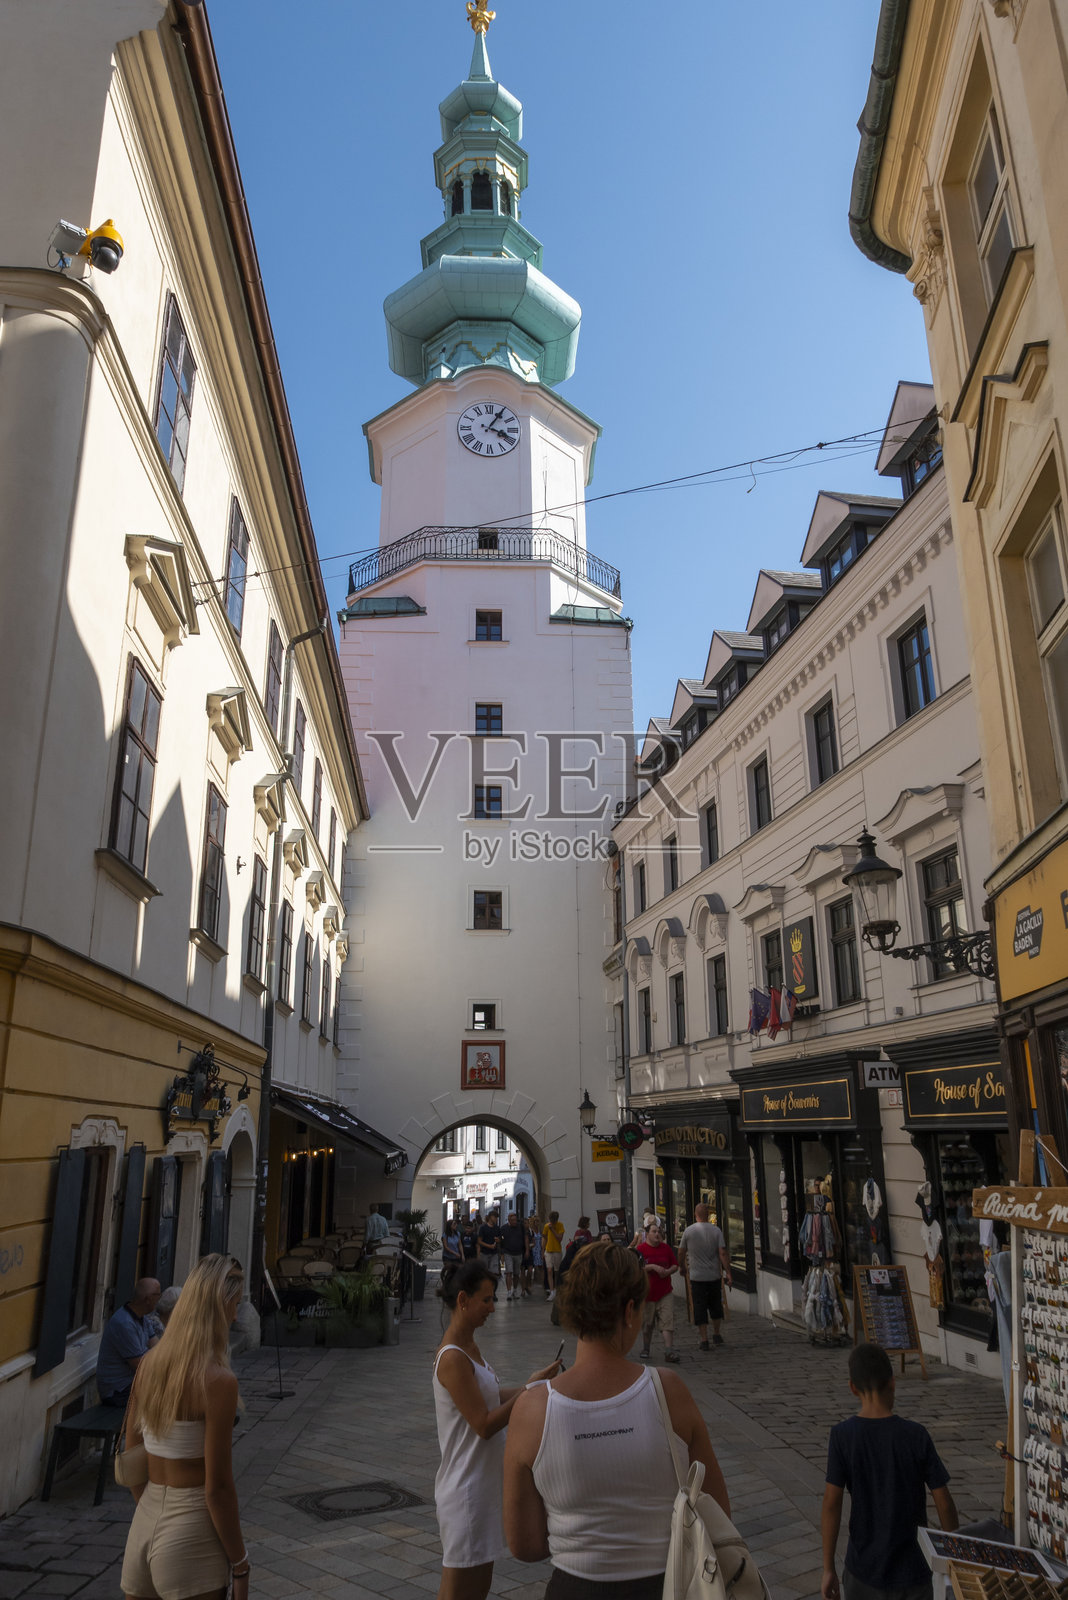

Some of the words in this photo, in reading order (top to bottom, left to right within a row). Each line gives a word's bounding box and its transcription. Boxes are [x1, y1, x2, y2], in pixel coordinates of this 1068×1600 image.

[1016, 923, 1024, 937] LA
[1014, 933, 1033, 953] BADEN
[868, 1066, 900, 1081] ATM
[762, 1094, 780, 1114] House
[780, 1095, 788, 1117] of
[788, 1090, 820, 1111] Souvenirs
[933, 1077, 967, 1104] House
[968, 1076, 982, 1109] of
[983, 1191, 1043, 1222] Ručná
